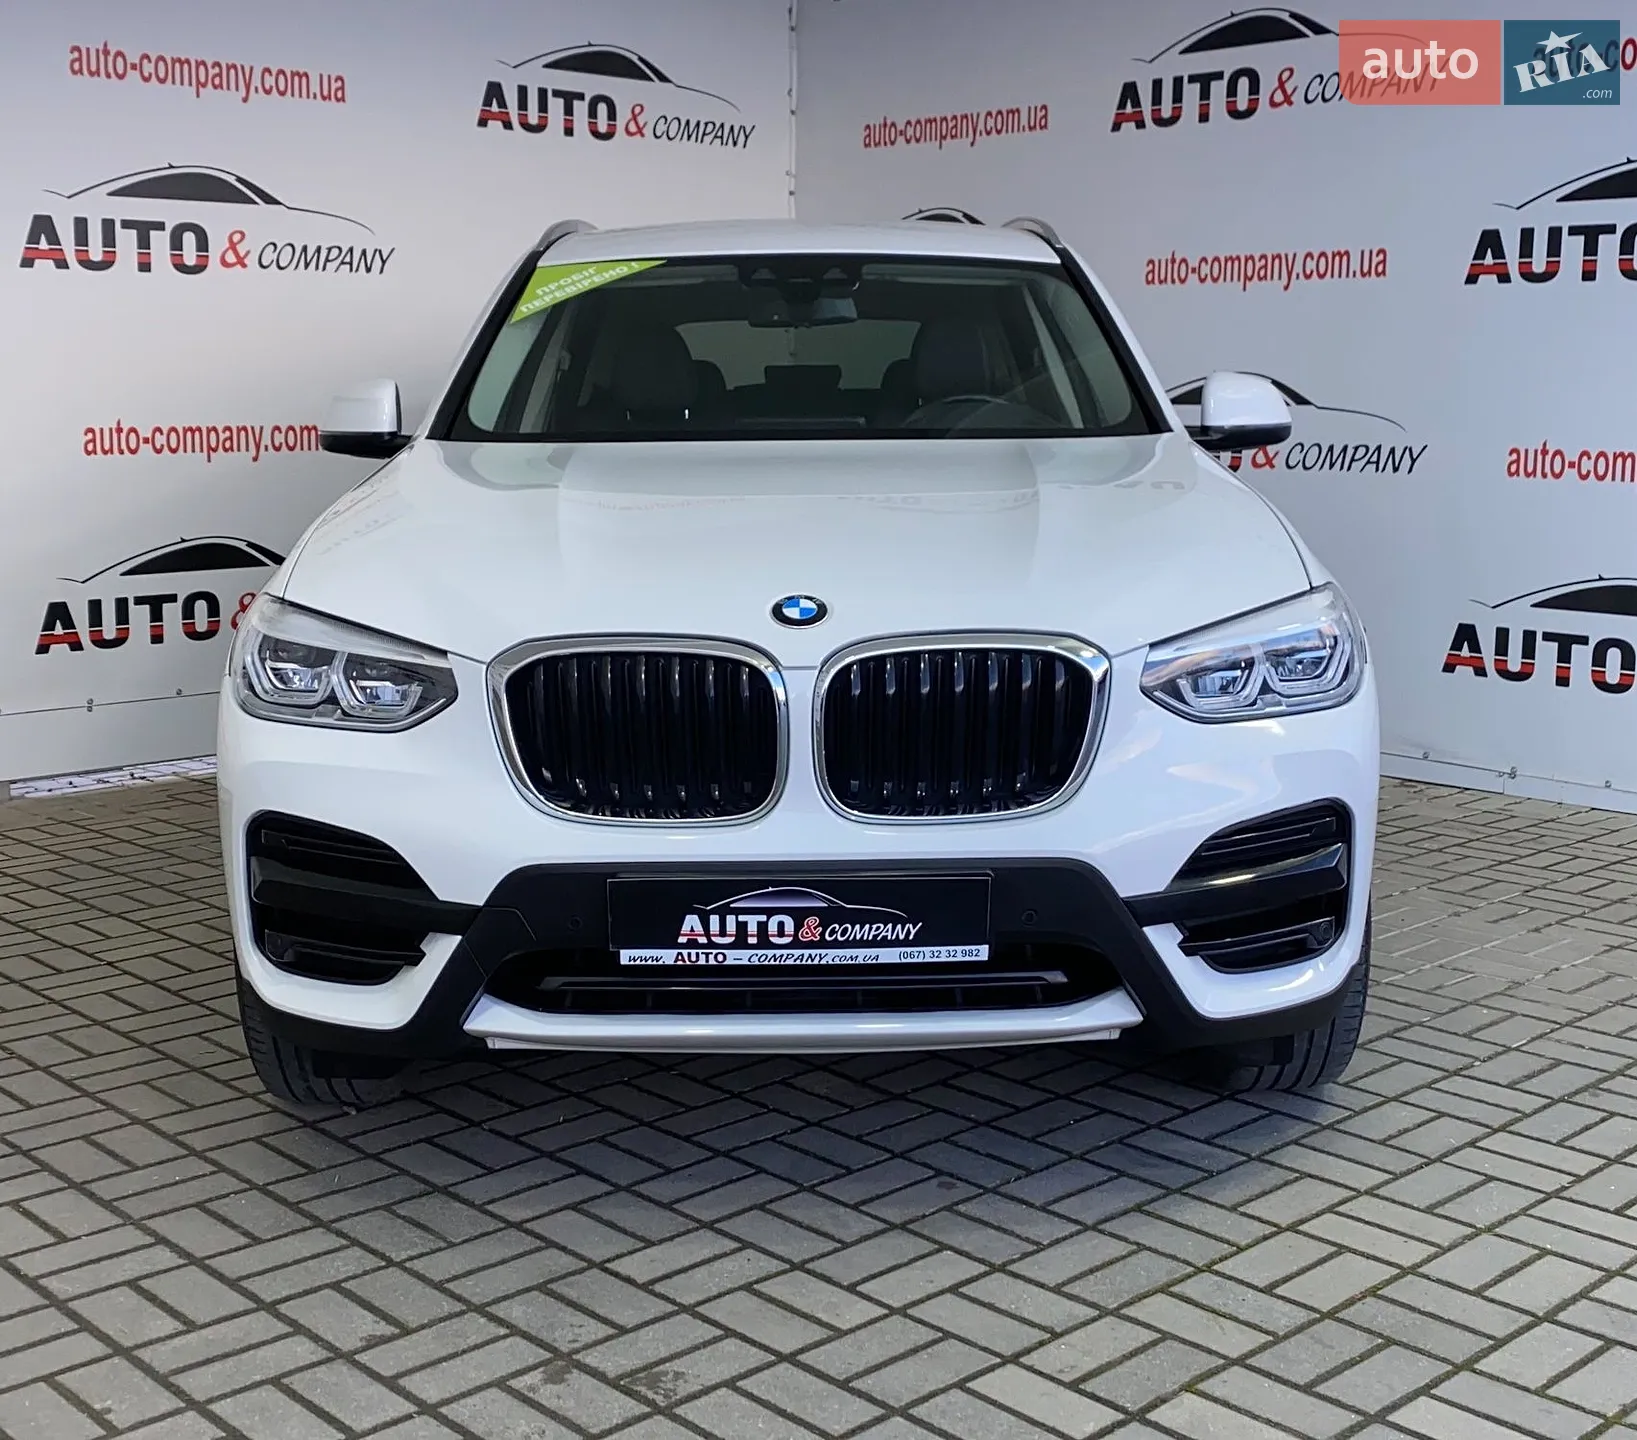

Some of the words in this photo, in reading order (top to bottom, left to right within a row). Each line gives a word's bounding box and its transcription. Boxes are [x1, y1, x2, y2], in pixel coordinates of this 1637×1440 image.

[69, 41, 346, 103] auto-company.com.ua
[477, 81, 617, 141] AUTO
[625, 104, 647, 138] &
[653, 115, 755, 149] COMPANY
[1110, 66, 1261, 132] AUTO
[1269, 67, 1298, 109] &
[863, 104, 1048, 149] auto-company.com.ua
[20, 214, 209, 275] AUTO
[220, 230, 250, 269] &
[258, 244, 395, 275] COMPANY
[1145, 248, 1388, 292] auto-company.com.ua
[1284, 442, 1429, 475] COMPANY
[34, 590, 222, 656] AUTO
[1441, 622, 1636, 694] AUTO
[677, 915, 795, 945] AUTO
[799, 917, 823, 942] &
[825, 922, 923, 942] COMPANY
[898, 949, 926, 961] (067)
[929, 950, 942, 959] 32
[945, 949, 958, 958] 32
[961, 948, 981, 957] 982
[673, 951, 728, 964] AUTO
